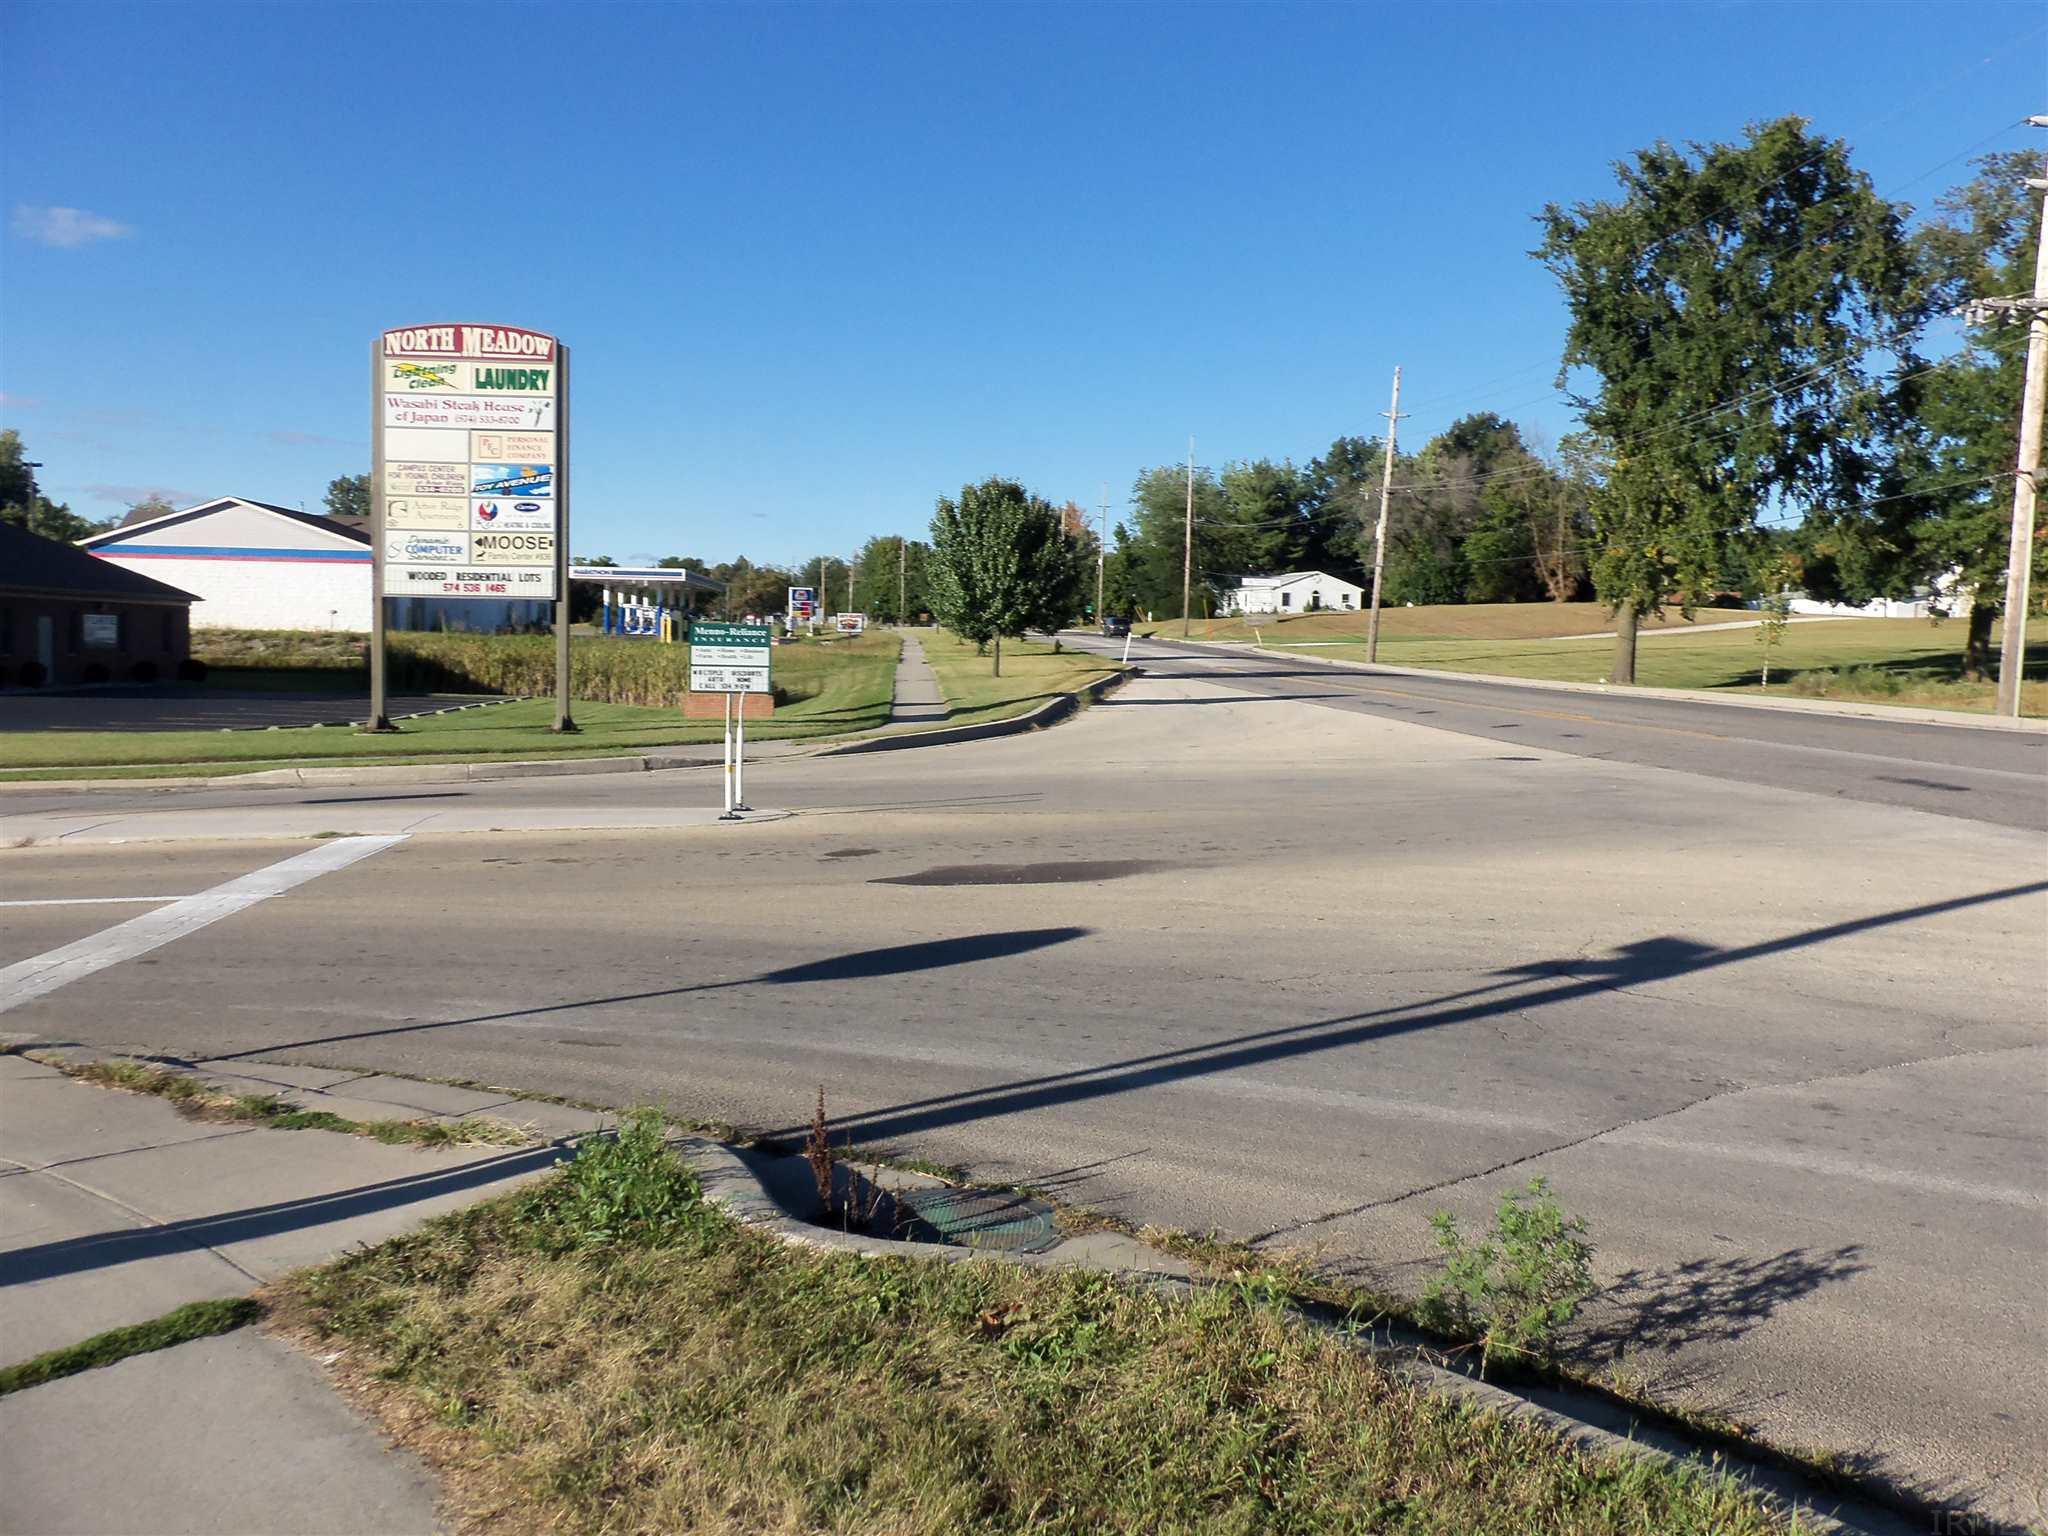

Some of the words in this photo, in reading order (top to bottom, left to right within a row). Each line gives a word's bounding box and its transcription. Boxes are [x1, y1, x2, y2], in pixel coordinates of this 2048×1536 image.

[384, 327, 456, 354] NORTH
[461, 327, 553, 357] MEADOW
[475, 368, 550, 391] LAUNDRY
[387, 397, 438, 410] Wasabi
[442, 399, 480, 412] Steak
[484, 401, 526, 412] House
[394, 410, 408, 421] of
[409, 410, 448, 424] Japan
[507, 436, 549, 444] PERSONAL
[507, 444, 543, 452] FINANCE
[507, 452, 547, 460] COMPANY
[495, 474, 553, 489] AVENUE
[483, 535, 549, 550] MOOSE
[405, 544, 463, 554] COMPUTER
[407, 571, 447, 580] WOODED
[456, 572, 512, 582] RESIDENTIAL
[519, 573, 541, 582] LOTS
[443, 583, 459, 592] 574
[694, 626, 767, 637] Menno-Reliance
